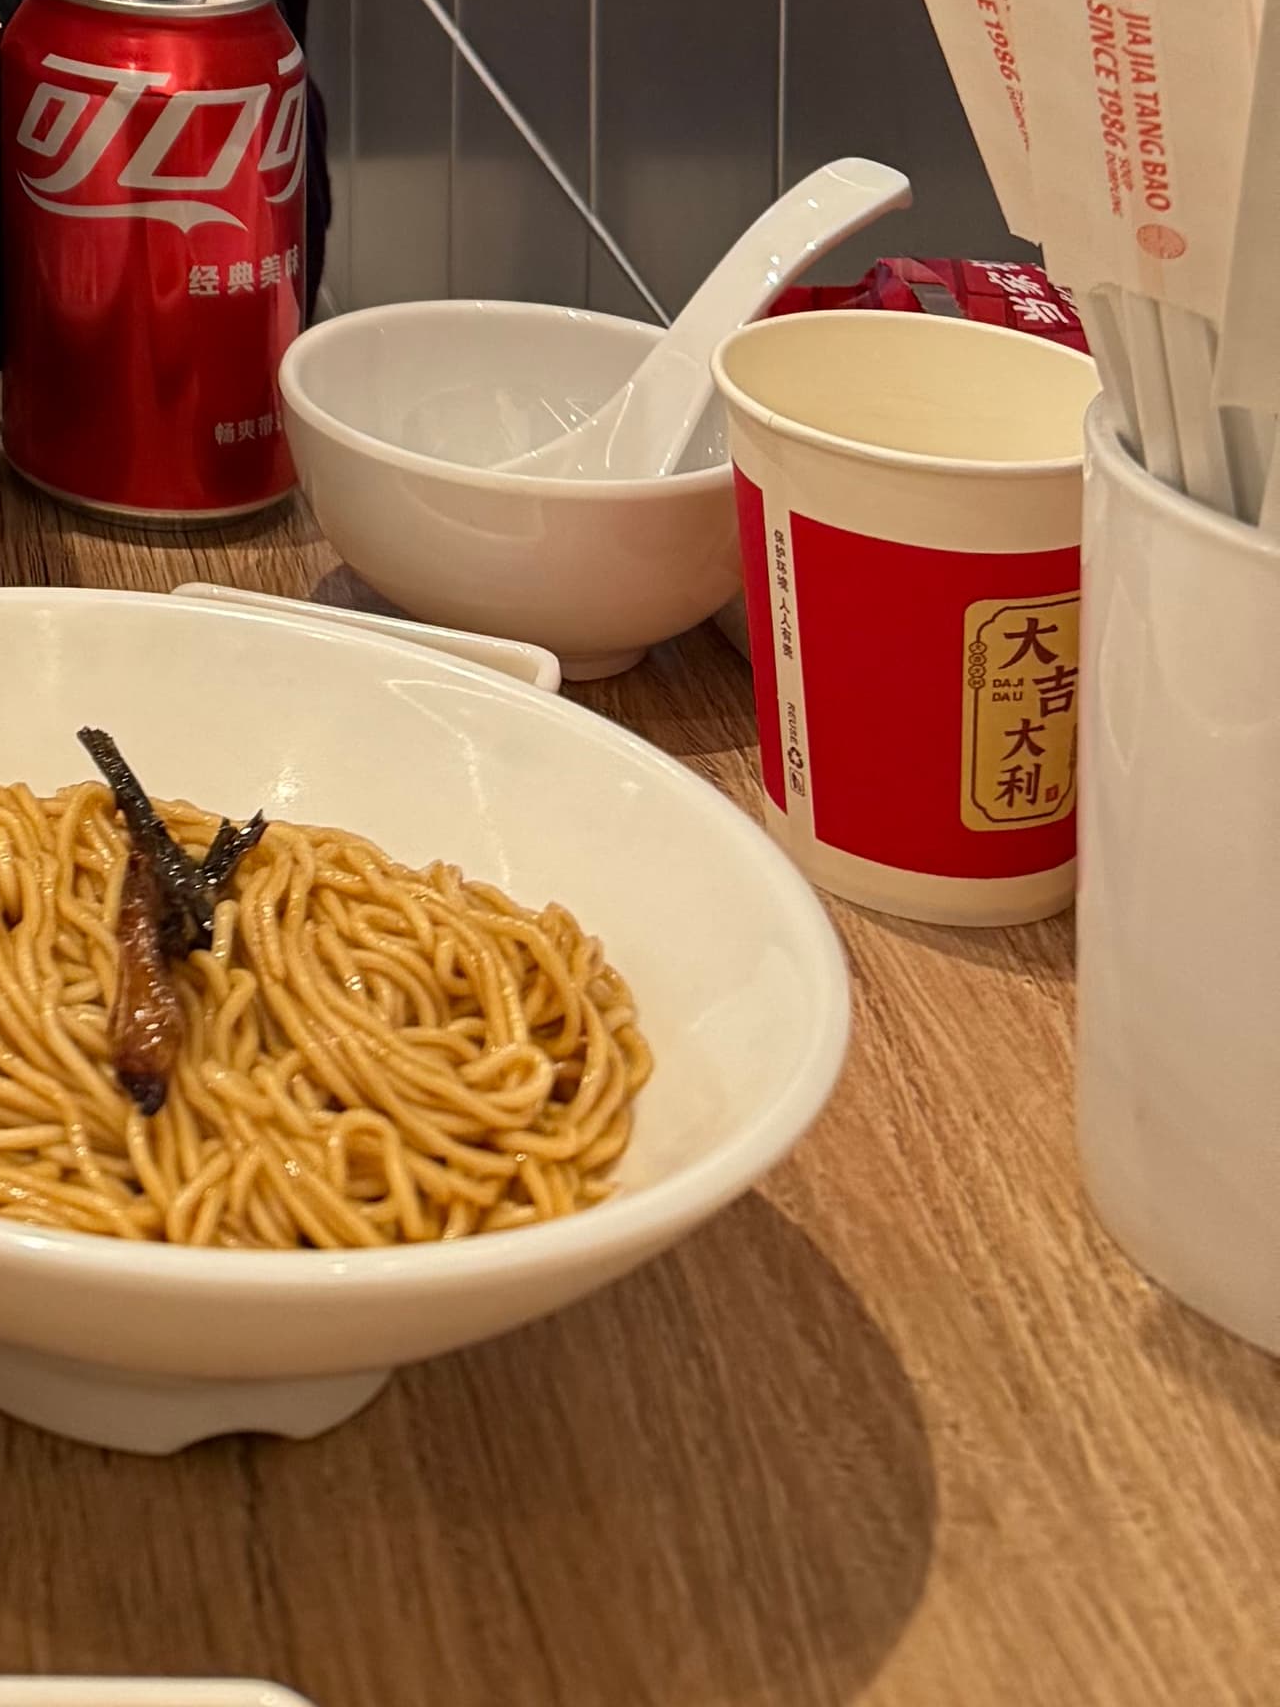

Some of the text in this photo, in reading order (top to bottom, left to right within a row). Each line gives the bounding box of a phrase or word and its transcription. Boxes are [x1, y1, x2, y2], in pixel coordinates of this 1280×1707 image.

[1117, 7, 1152, 46] JIA
[985, 20, 1021, 83] 1986
[1122, 46, 1157, 84] JIA
[1097, 86, 1128, 151] 1986
[1134, 91, 1166, 157] TANG
[1141, 160, 1171, 213] BAO
[991, 691, 1011, 702] DA
[992, 677, 1025, 688] DA JI
[786, 701, 800, 747] REUSE
[994, 617, 1080, 809] 大吉大利
